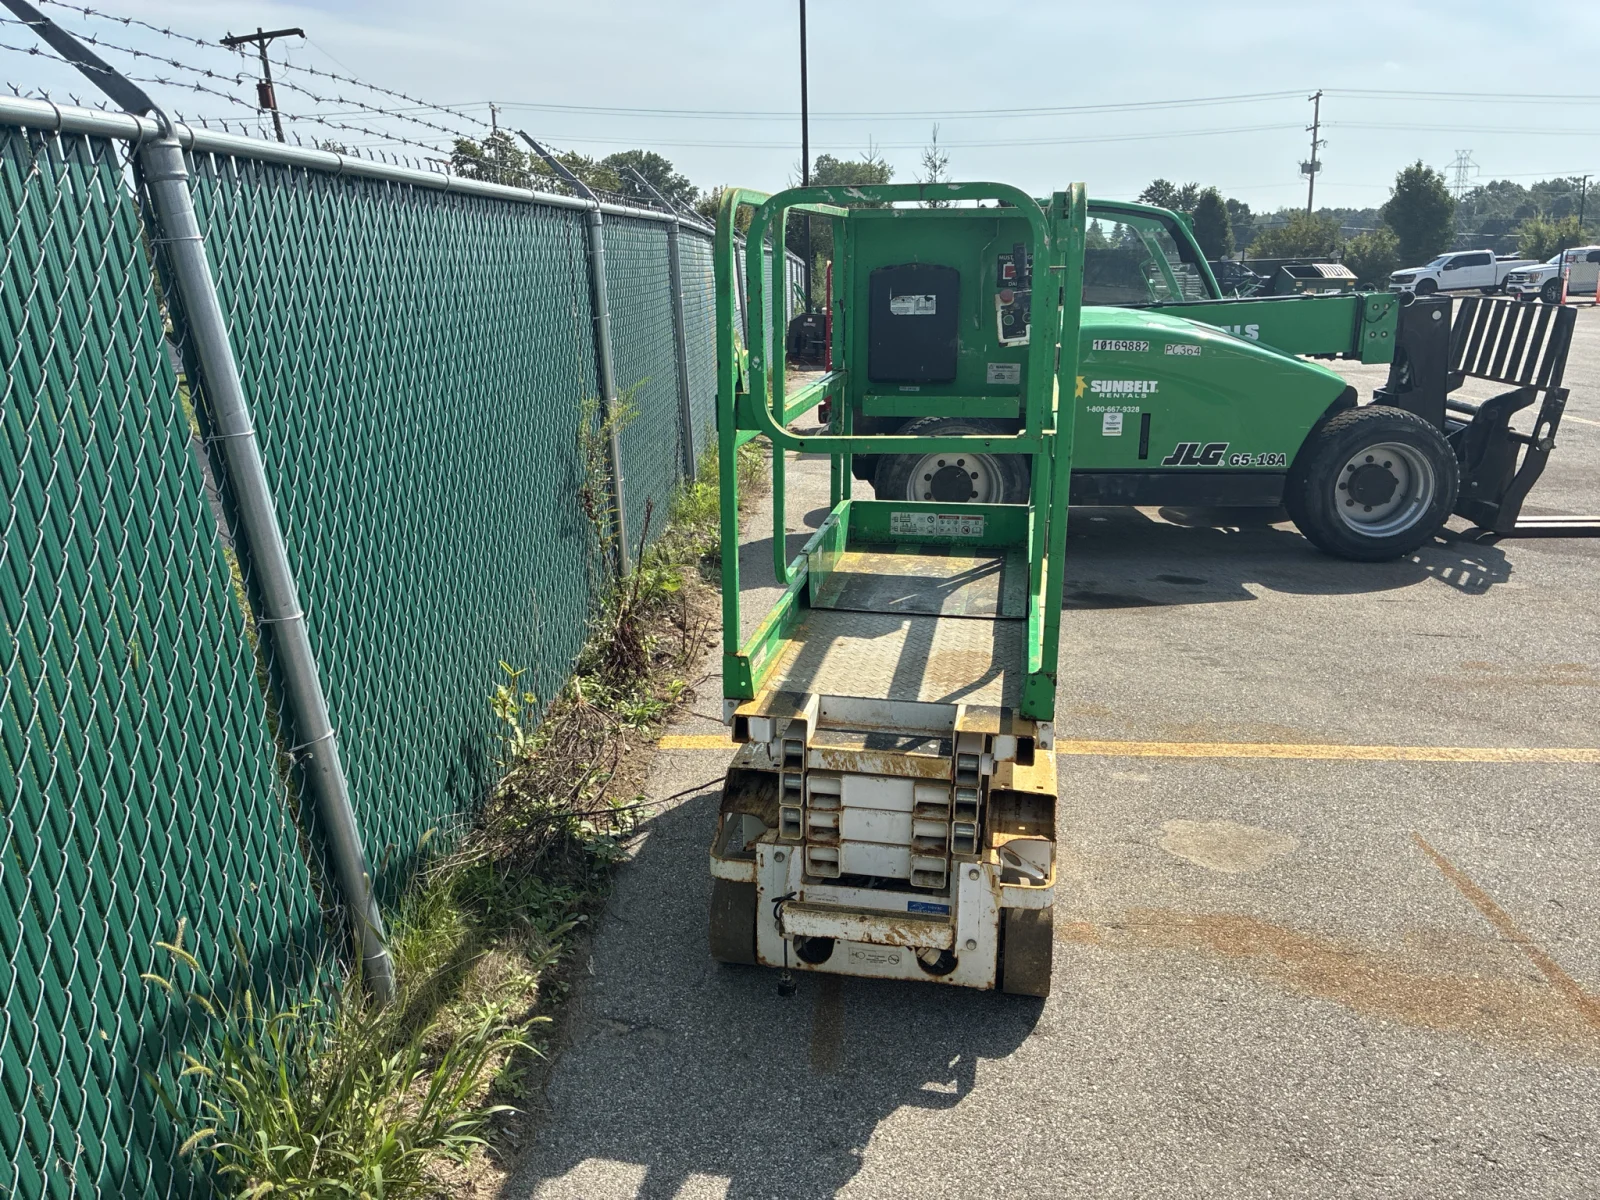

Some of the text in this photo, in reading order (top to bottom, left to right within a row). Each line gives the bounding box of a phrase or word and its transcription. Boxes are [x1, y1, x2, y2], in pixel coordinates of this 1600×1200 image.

[1094, 341, 1149, 351] 10169882
[1165, 345, 1200, 355] PC364
[1090, 380, 1159, 393] SUNBELT
[1161, 442, 1230, 467] JLG
[1229, 453, 1286, 466] G5-18A
